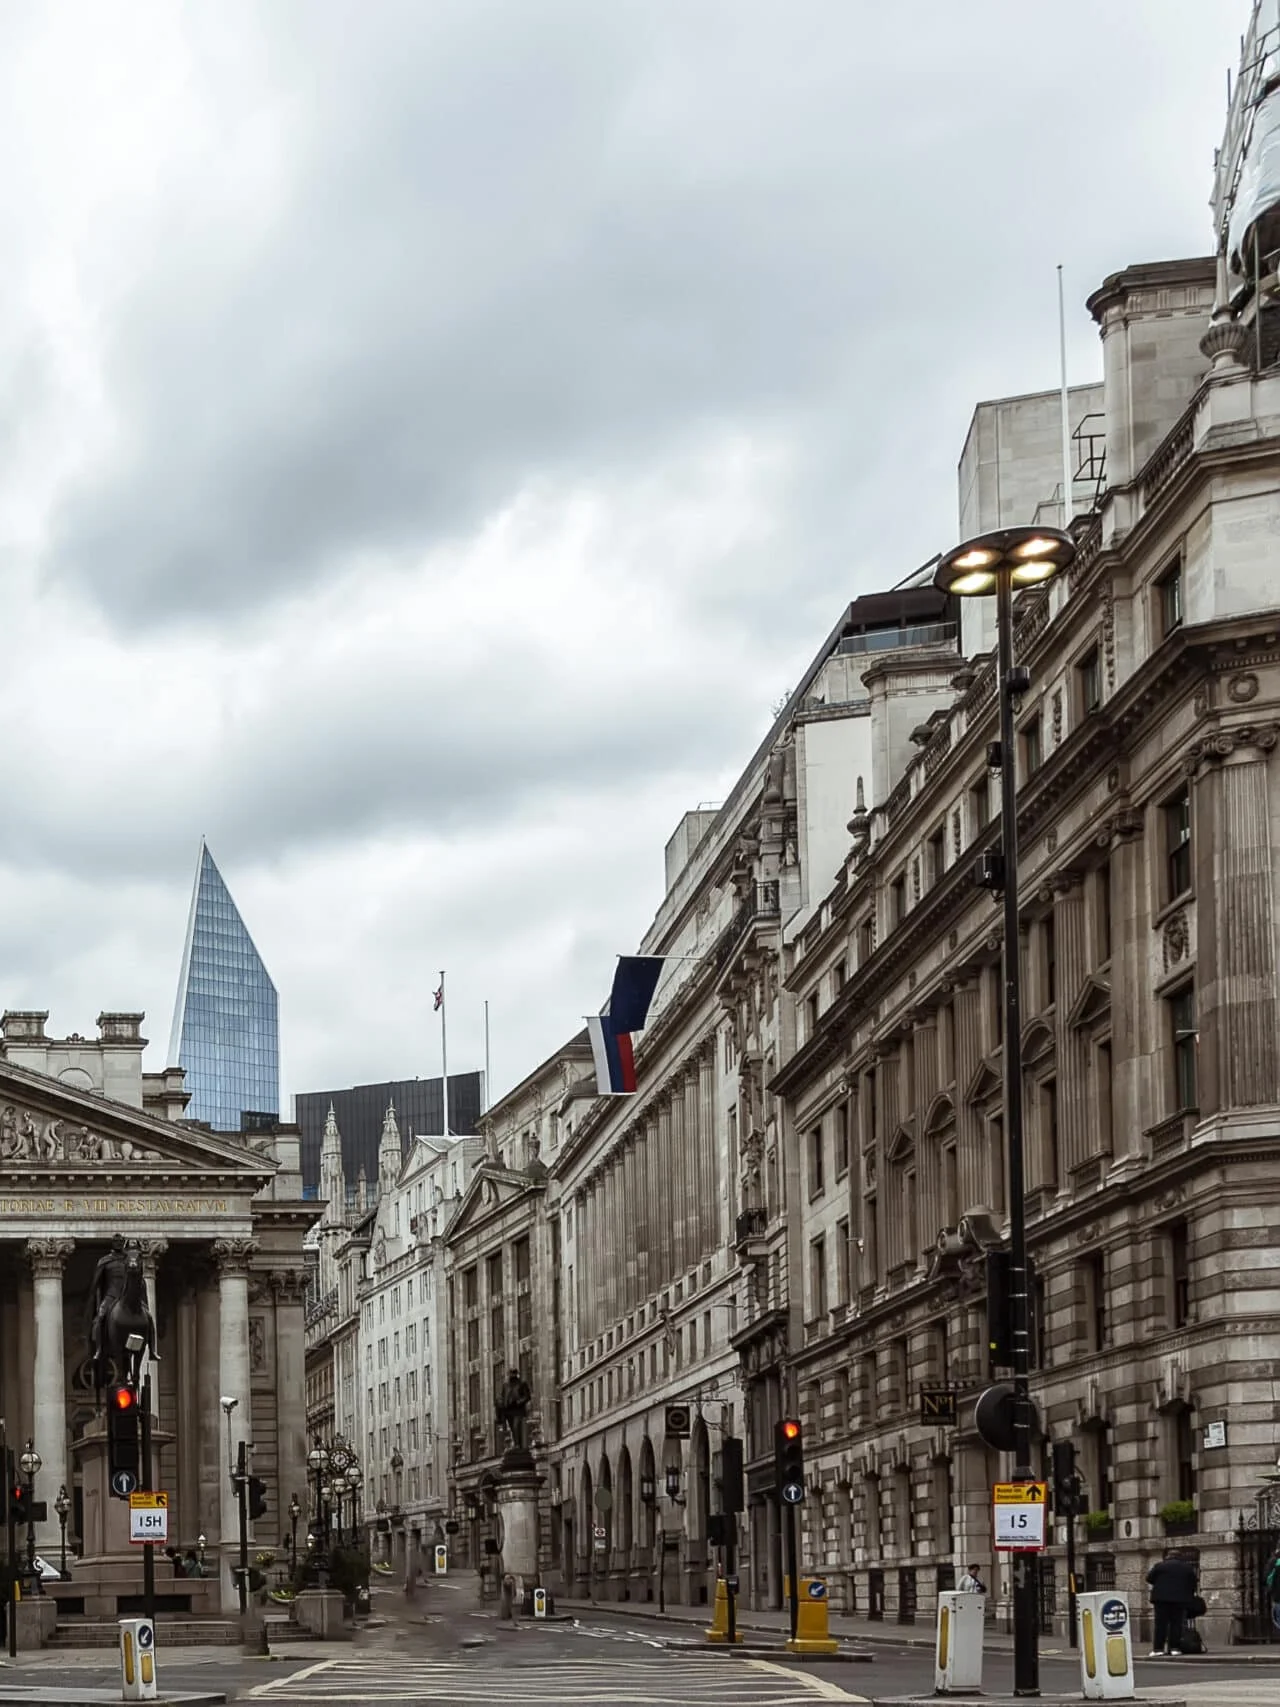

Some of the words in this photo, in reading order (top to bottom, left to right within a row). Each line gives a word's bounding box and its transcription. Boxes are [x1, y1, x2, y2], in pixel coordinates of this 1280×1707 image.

[83, 1199, 108, 1212] VIII
[117, 1199, 227, 1212] RESTAVRATVM
[140, 1515, 162, 1527] 15H
[1011, 1514, 1027, 1528] 15
